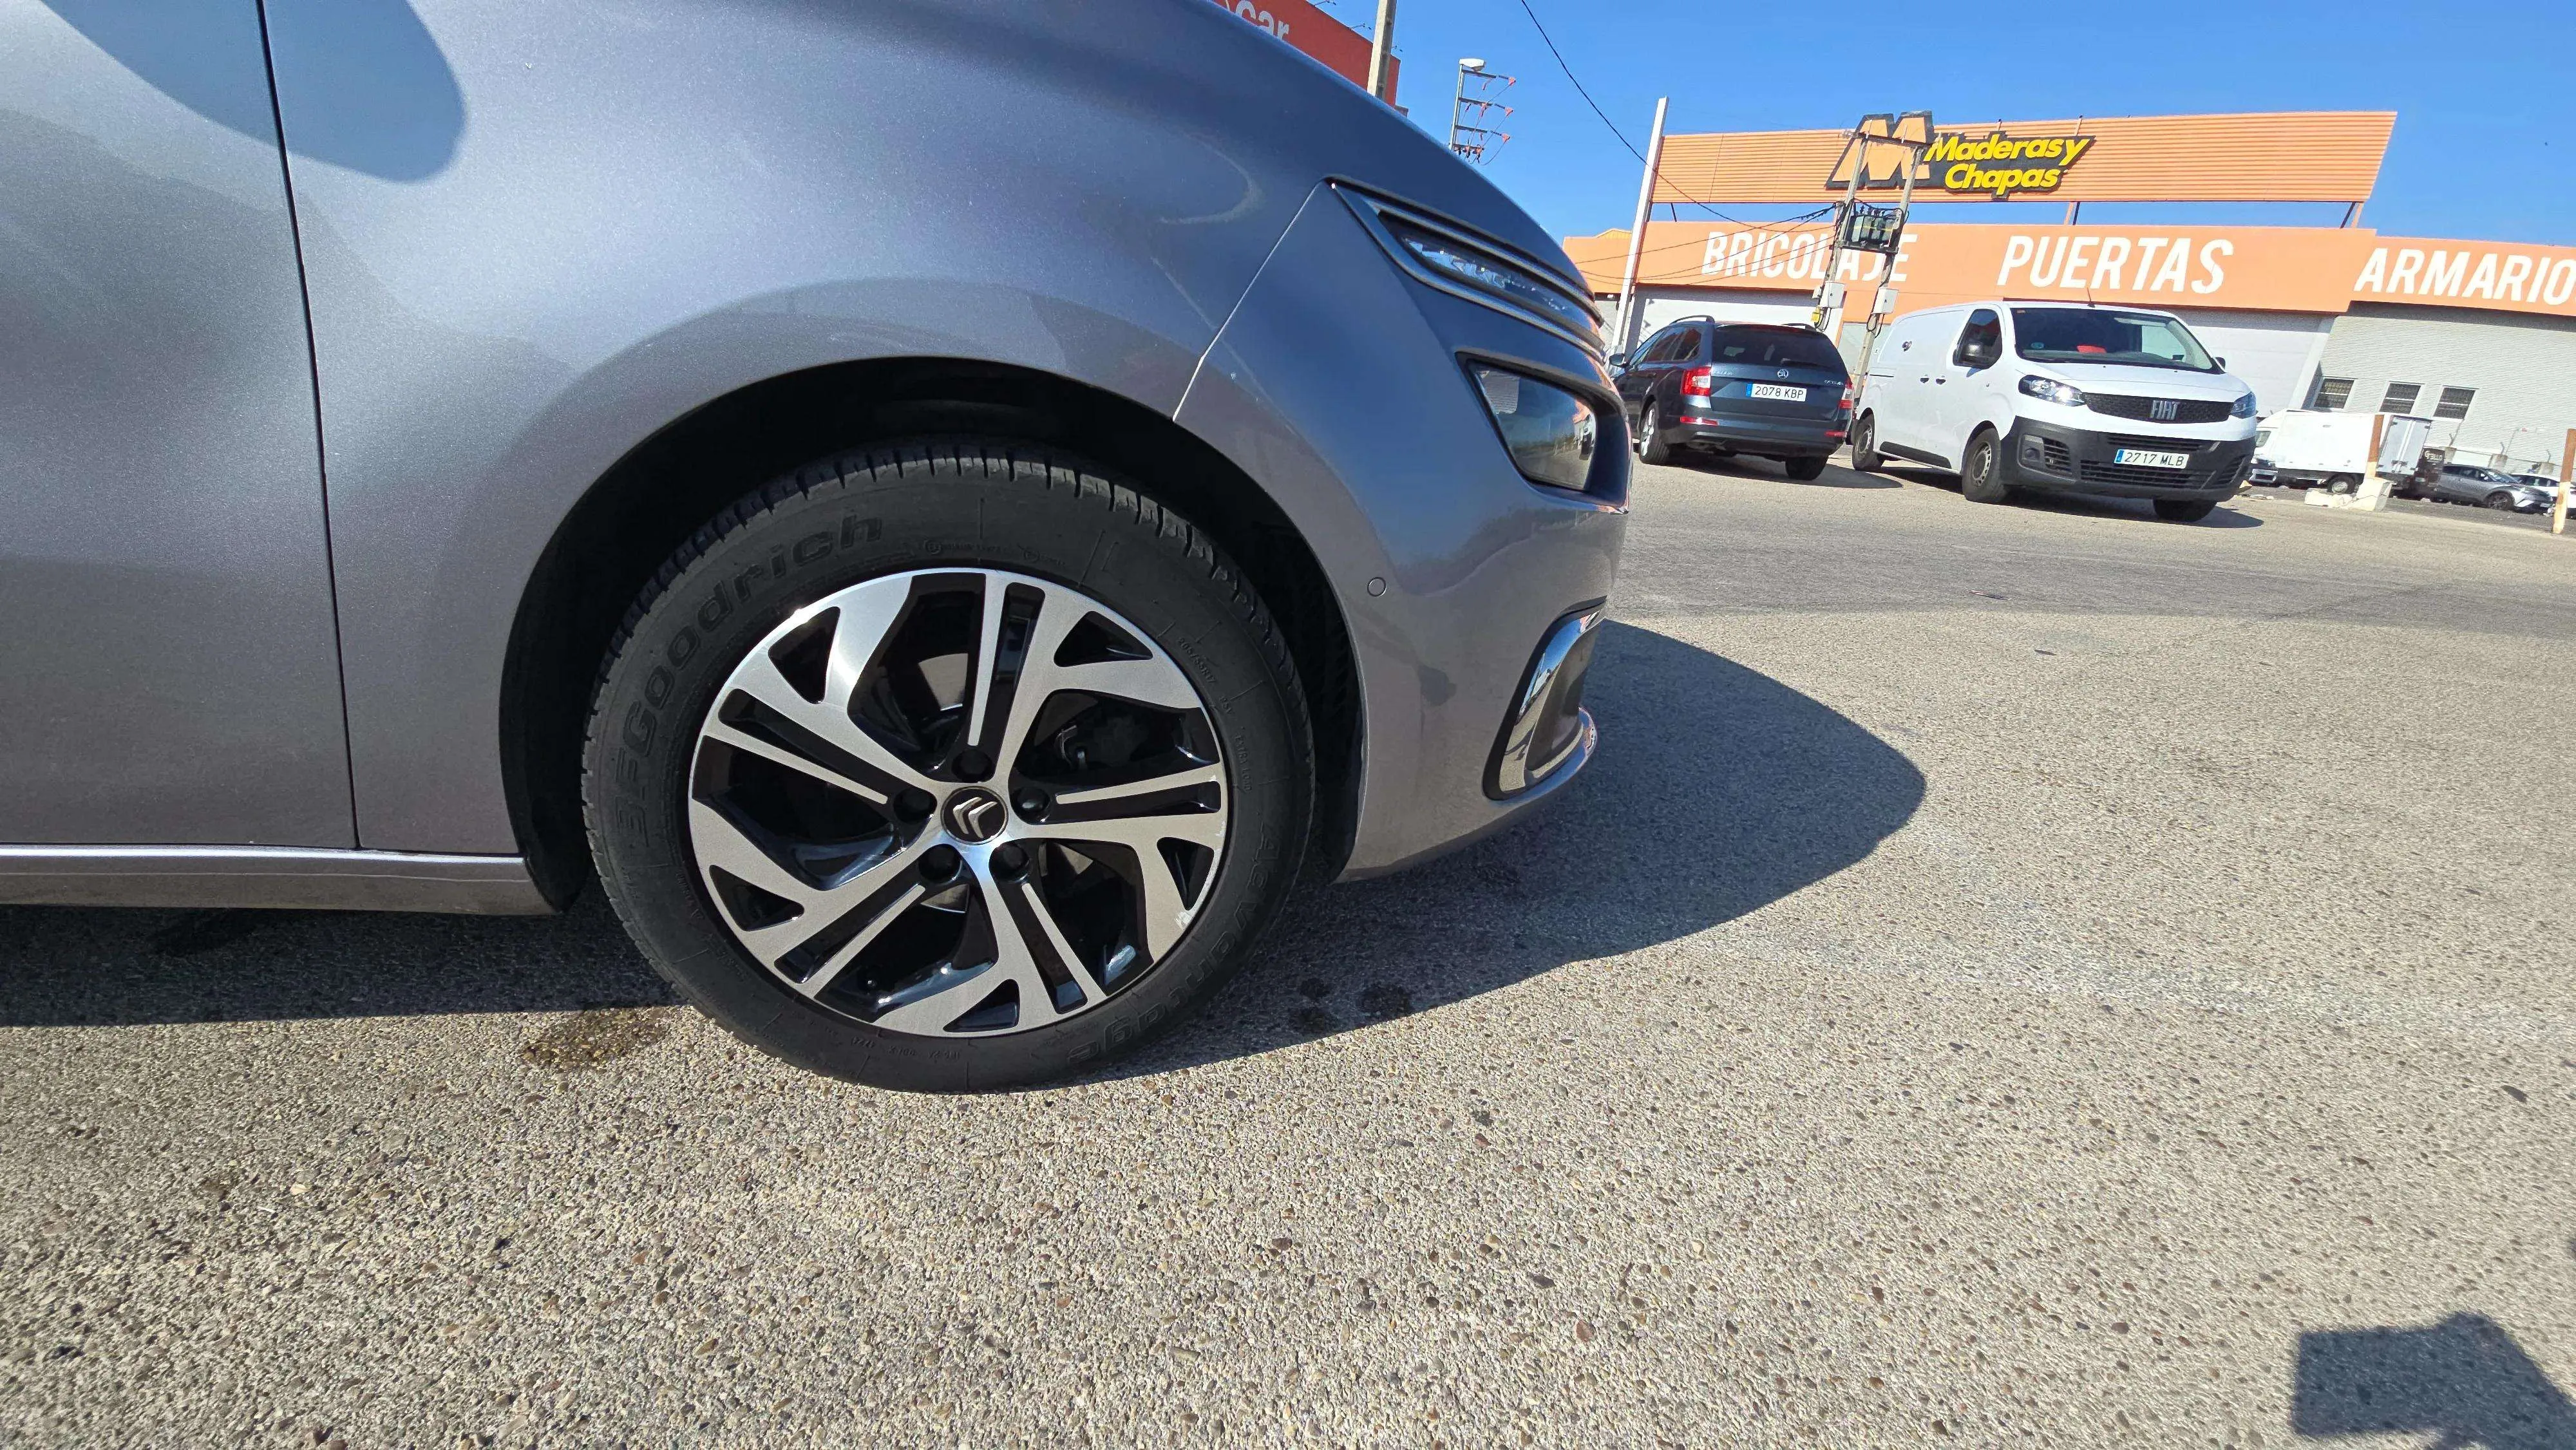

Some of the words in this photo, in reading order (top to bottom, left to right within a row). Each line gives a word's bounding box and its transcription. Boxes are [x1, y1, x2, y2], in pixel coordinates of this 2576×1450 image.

[1226, 0, 1289, 41] car
[1945, 163, 2060, 195] Chapas
[1701, 231, 1917, 282] BRICOLAJE
[1996, 235, 2234, 294] PUERTAS
[2354, 247, 2576, 305] ARMARIO
[1755, 386, 1781, 397] 2078
[1784, 388, 1803, 399] KBP
[2151, 400, 2179, 420] FIAT
[2125, 452, 2157, 464] 2717
[2161, 455, 2184, 466] MLB
